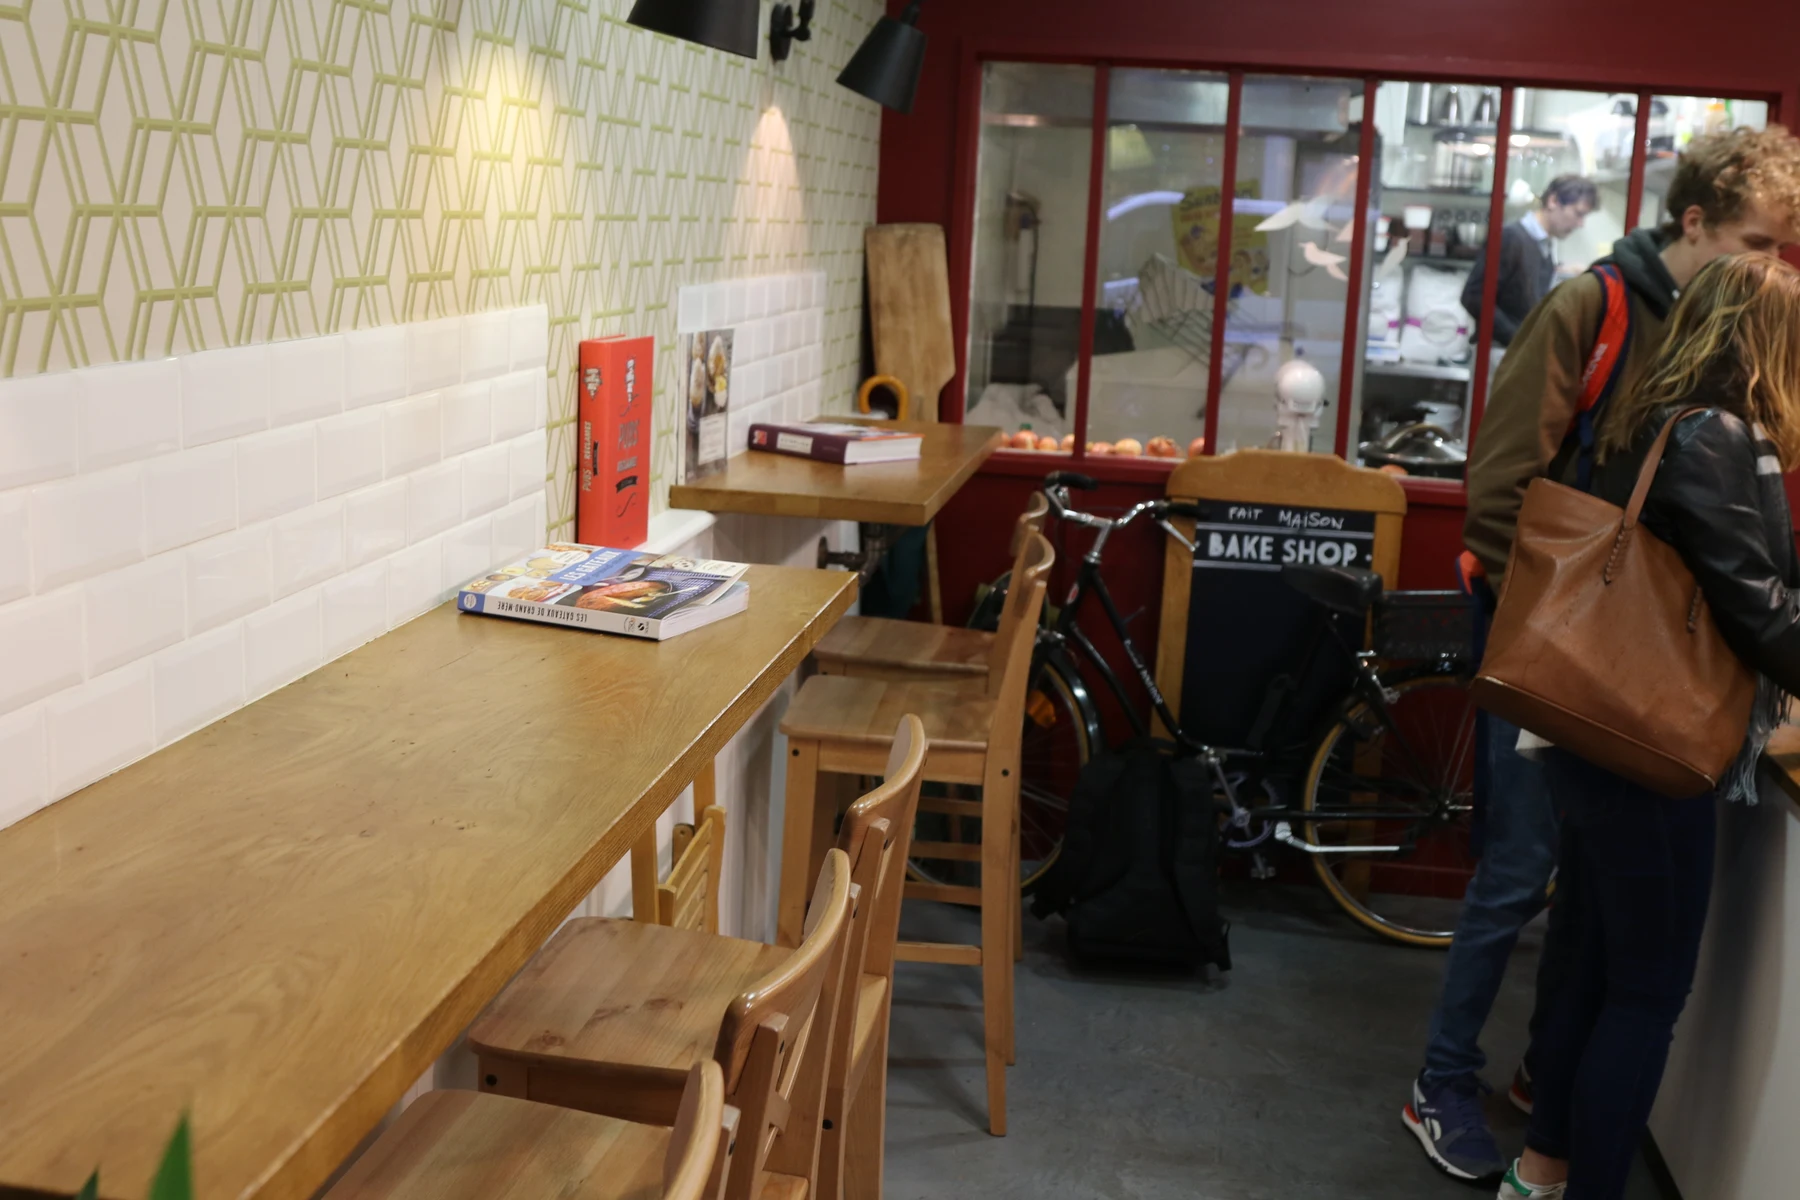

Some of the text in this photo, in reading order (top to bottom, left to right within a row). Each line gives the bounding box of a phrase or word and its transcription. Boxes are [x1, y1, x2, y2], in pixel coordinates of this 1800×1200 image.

[1208, 532, 1358, 567] BAKE SHOP
[537, 607, 545, 617] DE
[576, 613, 588, 623] LES
